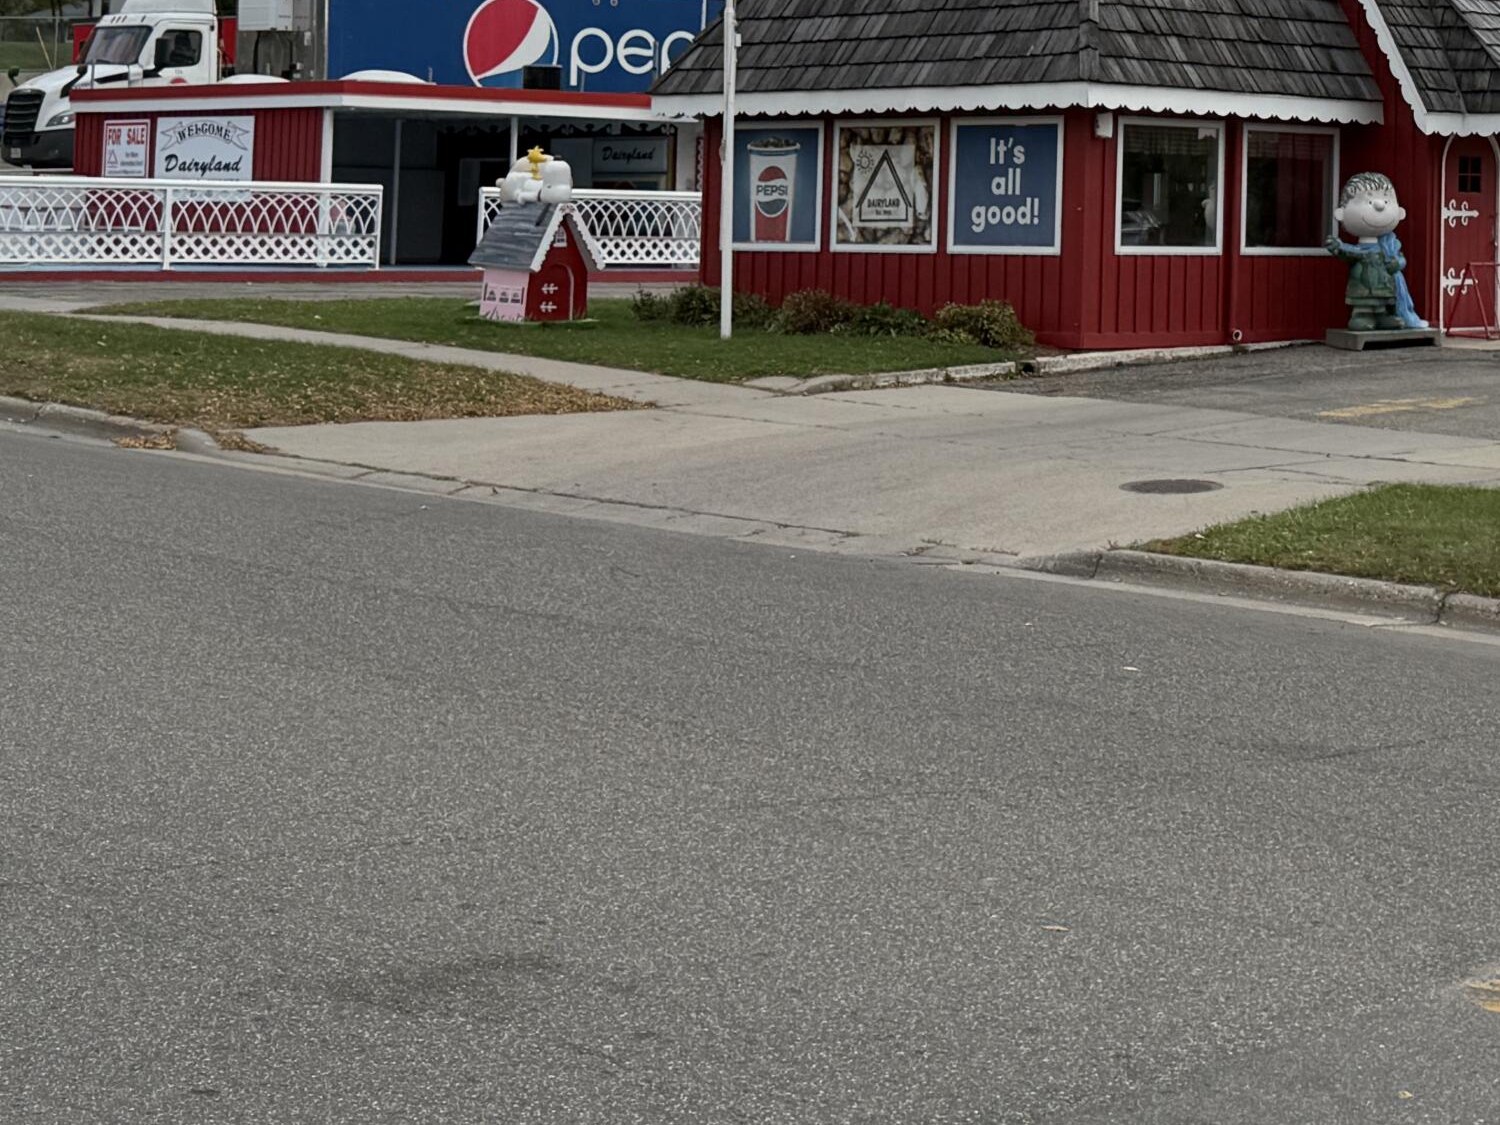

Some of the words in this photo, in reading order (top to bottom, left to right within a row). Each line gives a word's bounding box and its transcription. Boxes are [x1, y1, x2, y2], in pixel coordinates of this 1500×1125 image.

[107, 128, 121, 145] FOR
[127, 127, 145, 145] SALE
[177, 122, 231, 142] WELCOME
[602, 146, 657, 164] Dairyland
[989, 137, 1025, 164] It's
[164, 153, 243, 176] Dairyland
[756, 184, 788, 196] PEPSI
[991, 167, 1021, 195] all
[867, 198, 901, 208] DAIRYLAND
[971, 197, 1039, 233] good!
